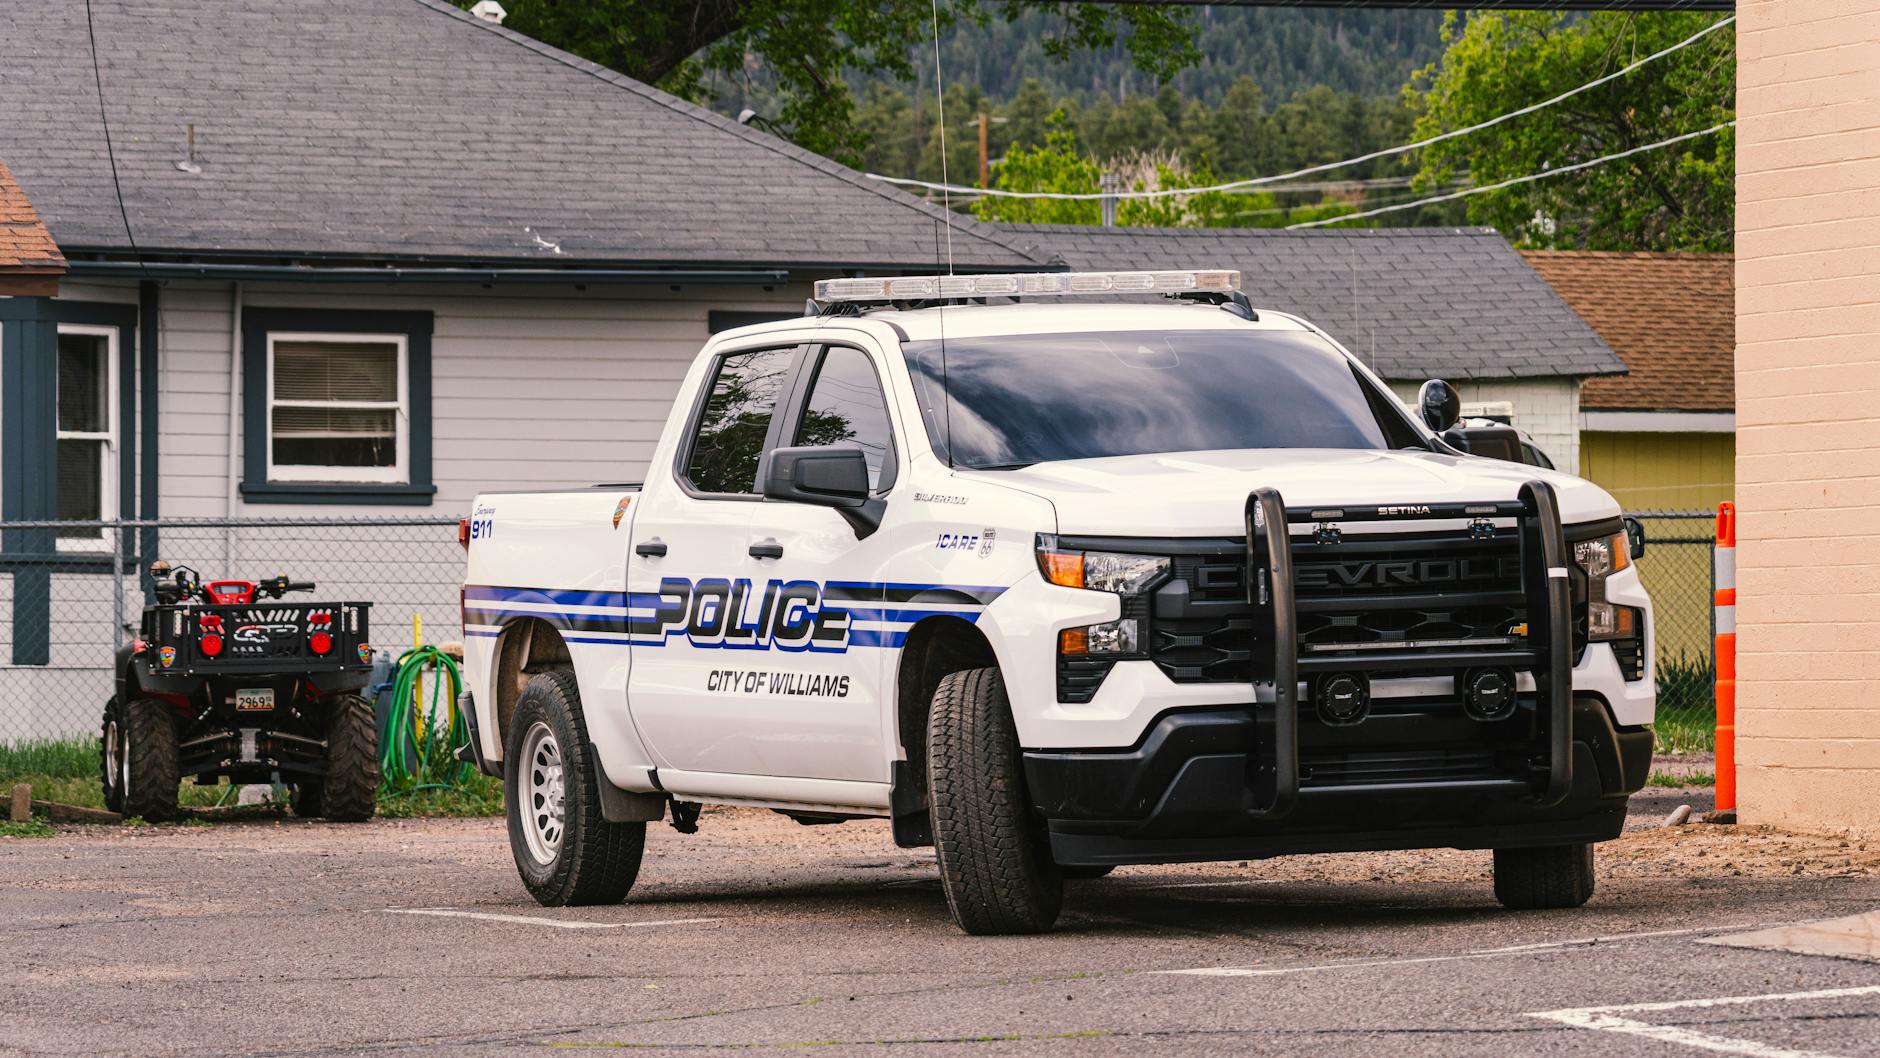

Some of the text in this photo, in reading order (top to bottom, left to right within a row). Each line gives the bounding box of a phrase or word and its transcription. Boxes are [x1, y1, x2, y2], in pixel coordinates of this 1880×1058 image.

[914, 492, 969, 505] SILVERADO
[1377, 505, 1431, 516] SETINA
[472, 520, 492, 539] 911
[980, 540, 992, 555] 66
[655, 576, 851, 654] POLICE
[707, 670, 850, 698] CITY OF WILLIAMS
[239, 696, 265, 708] 2969
